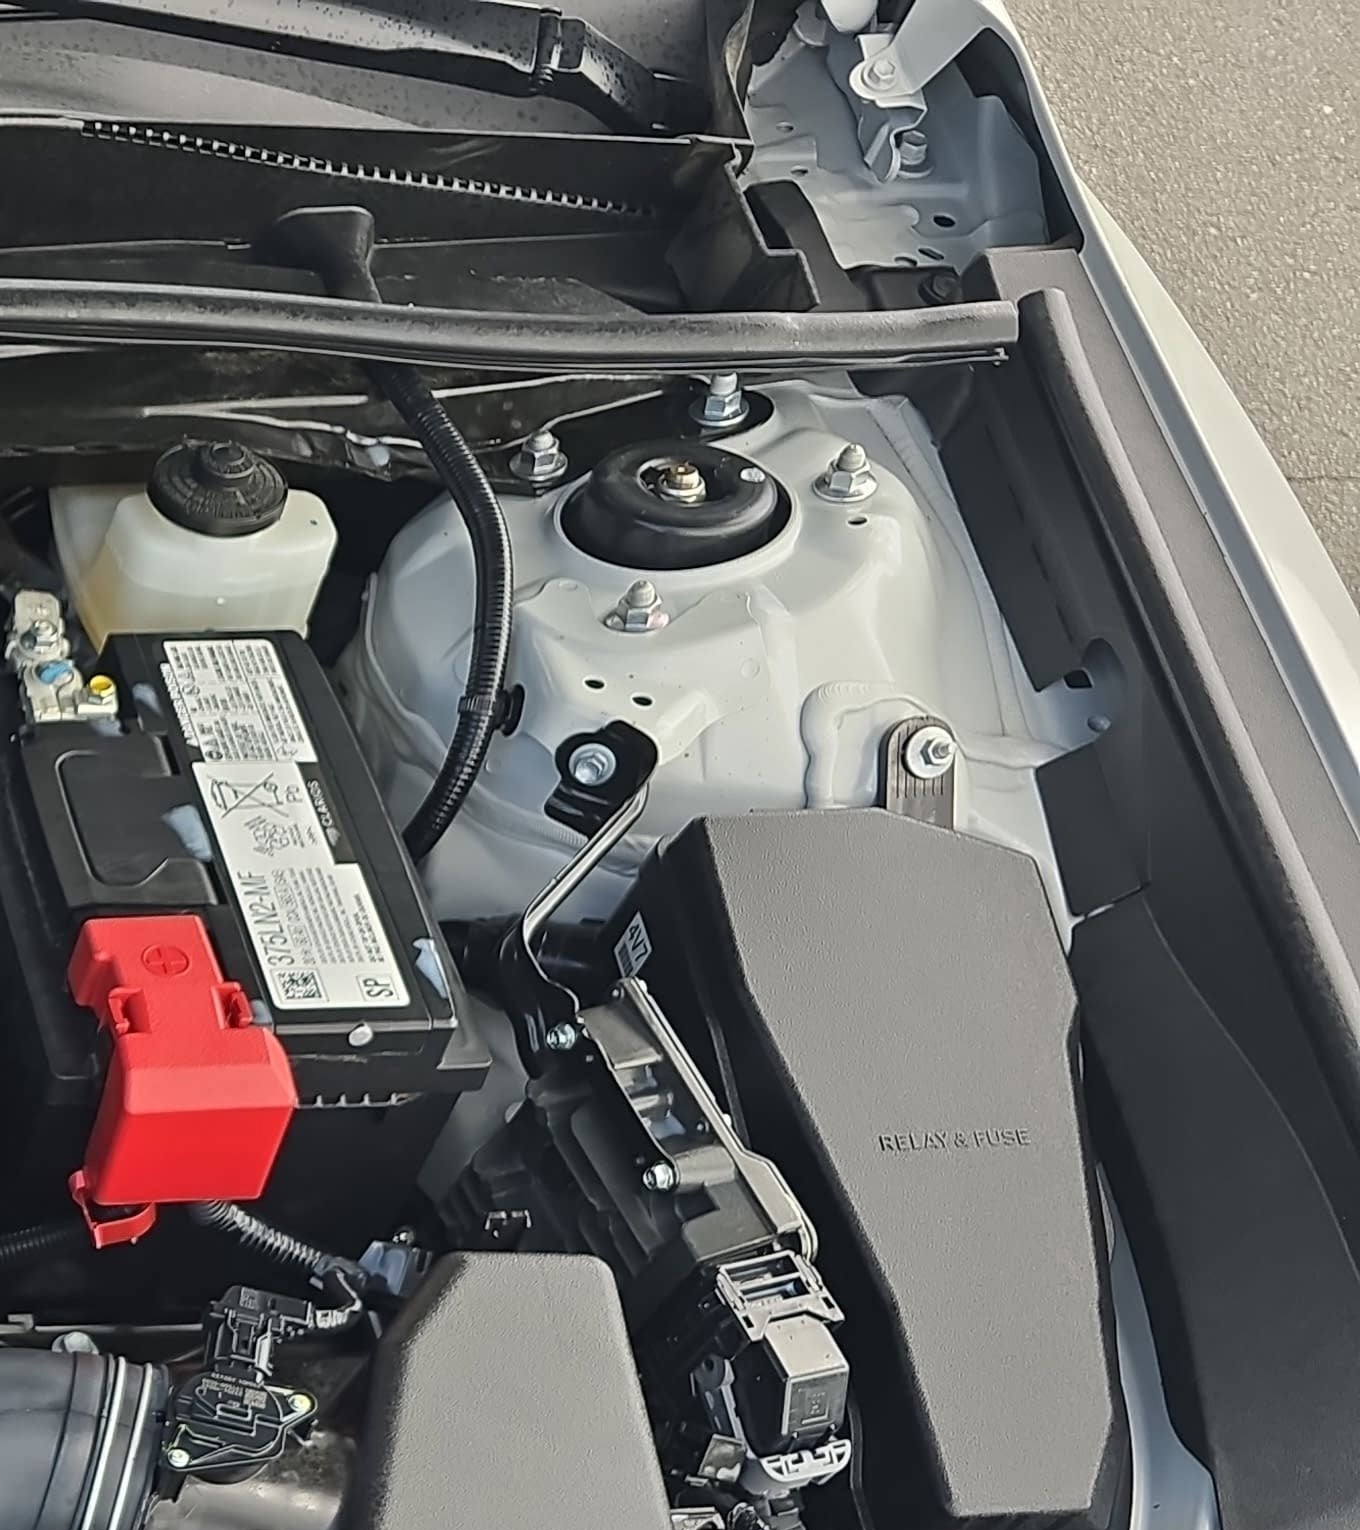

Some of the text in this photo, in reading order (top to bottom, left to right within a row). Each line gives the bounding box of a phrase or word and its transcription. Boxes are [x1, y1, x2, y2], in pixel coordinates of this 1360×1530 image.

[237, 871, 295, 966] 375LN2-MF
[363, 977, 394, 998] SP
[878, 1127, 1032, 1153] RELAY & FUSE
